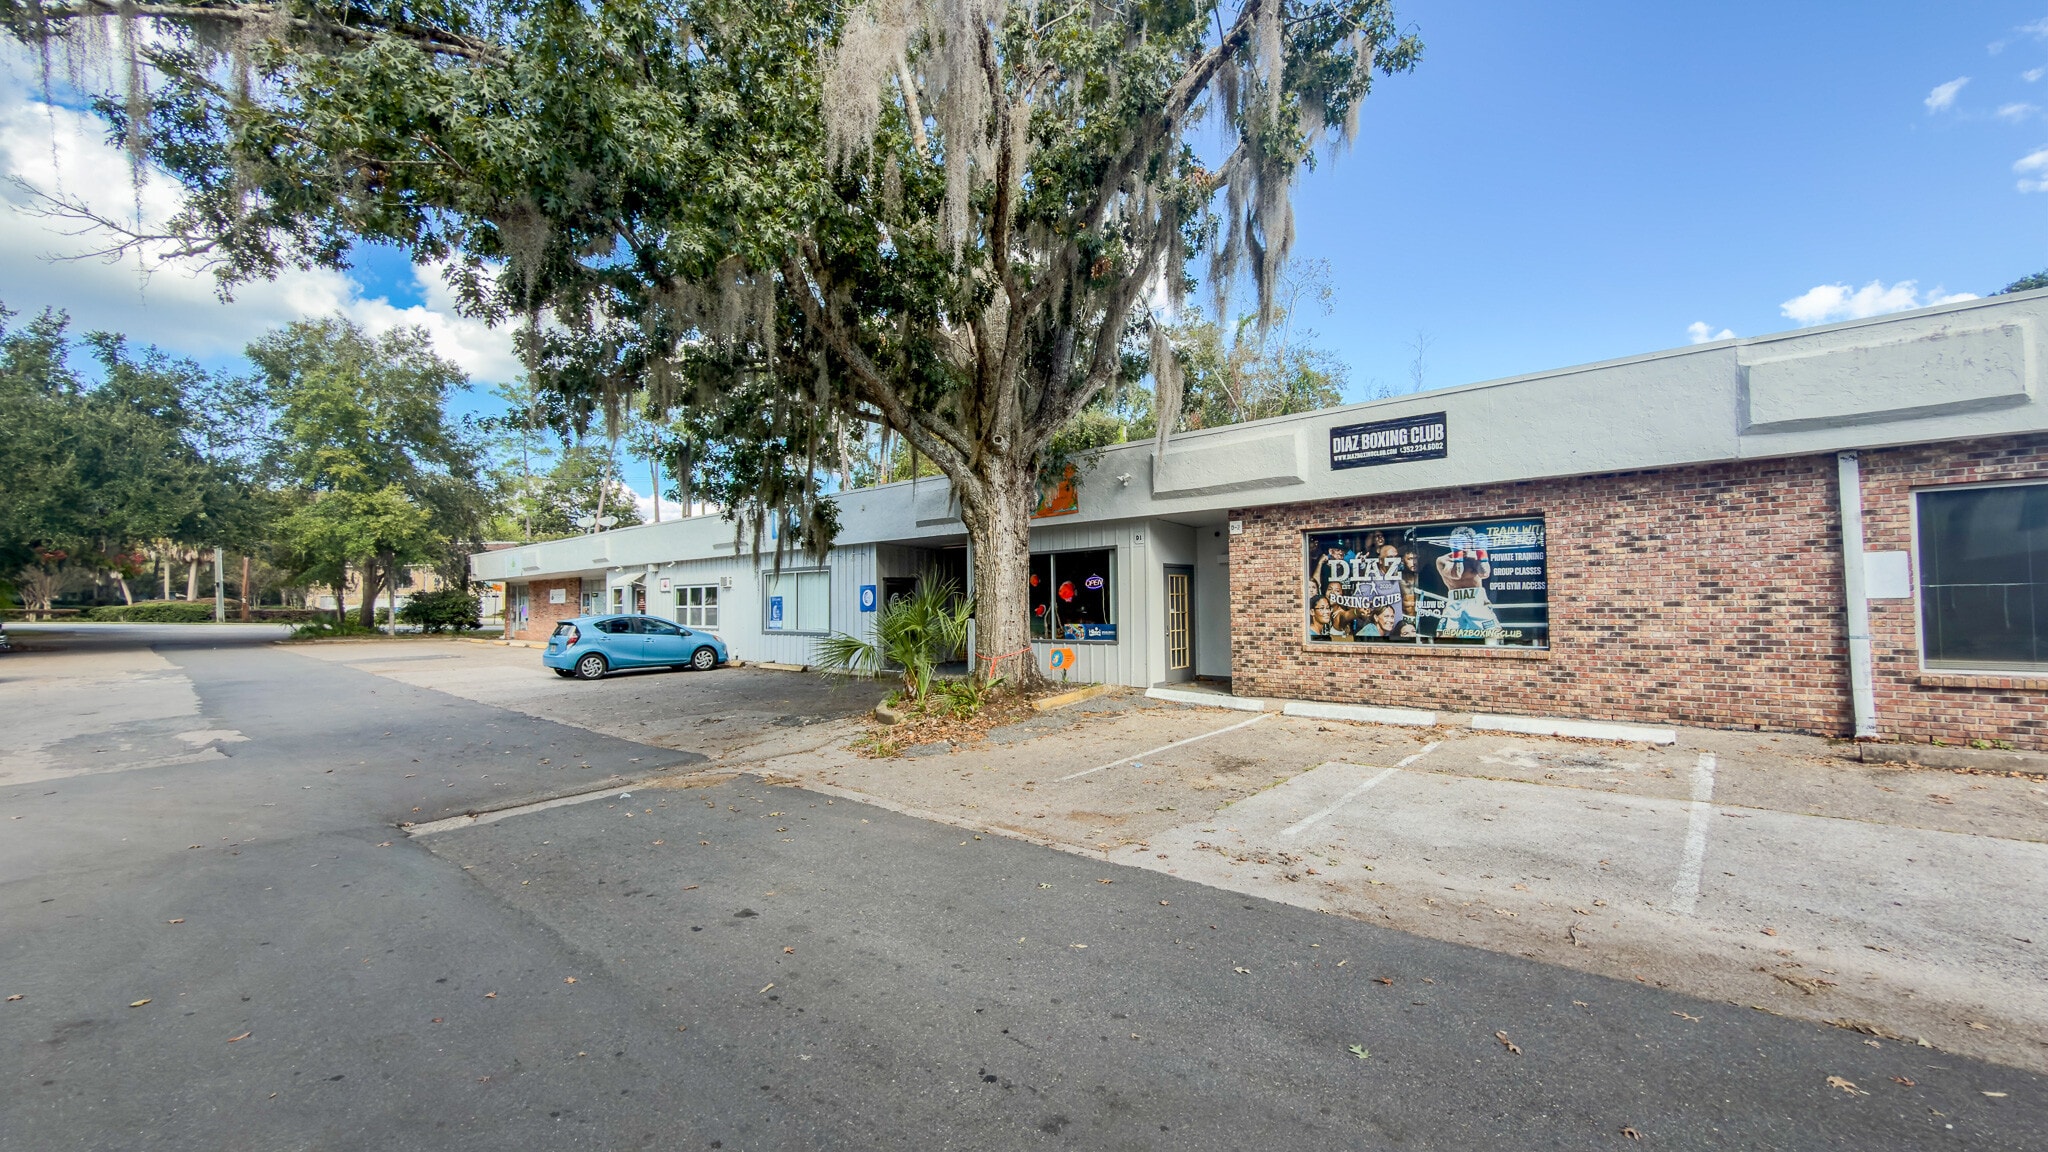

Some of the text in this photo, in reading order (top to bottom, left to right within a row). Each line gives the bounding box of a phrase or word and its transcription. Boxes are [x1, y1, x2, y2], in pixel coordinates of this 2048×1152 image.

[1333, 424, 1444, 453] DIAZ BOXING CLUB
[1486, 526, 1519, 536] TRAIN
[1490, 552, 1544, 562] PRIVATE TRAINING
[1329, 557, 1402, 581] DIAZ
[1493, 567, 1541, 576] GROUP CLASSES
[1489, 581, 1546, 590] OPEN GYM ACCESS
[1453, 588, 1476, 600] DIAZ
[1330, 593, 1401, 609] BOXING CLUB
[1437, 600, 1445, 609] US
[1443, 628, 1523, 638] @DIAZBOXINGCLUB
